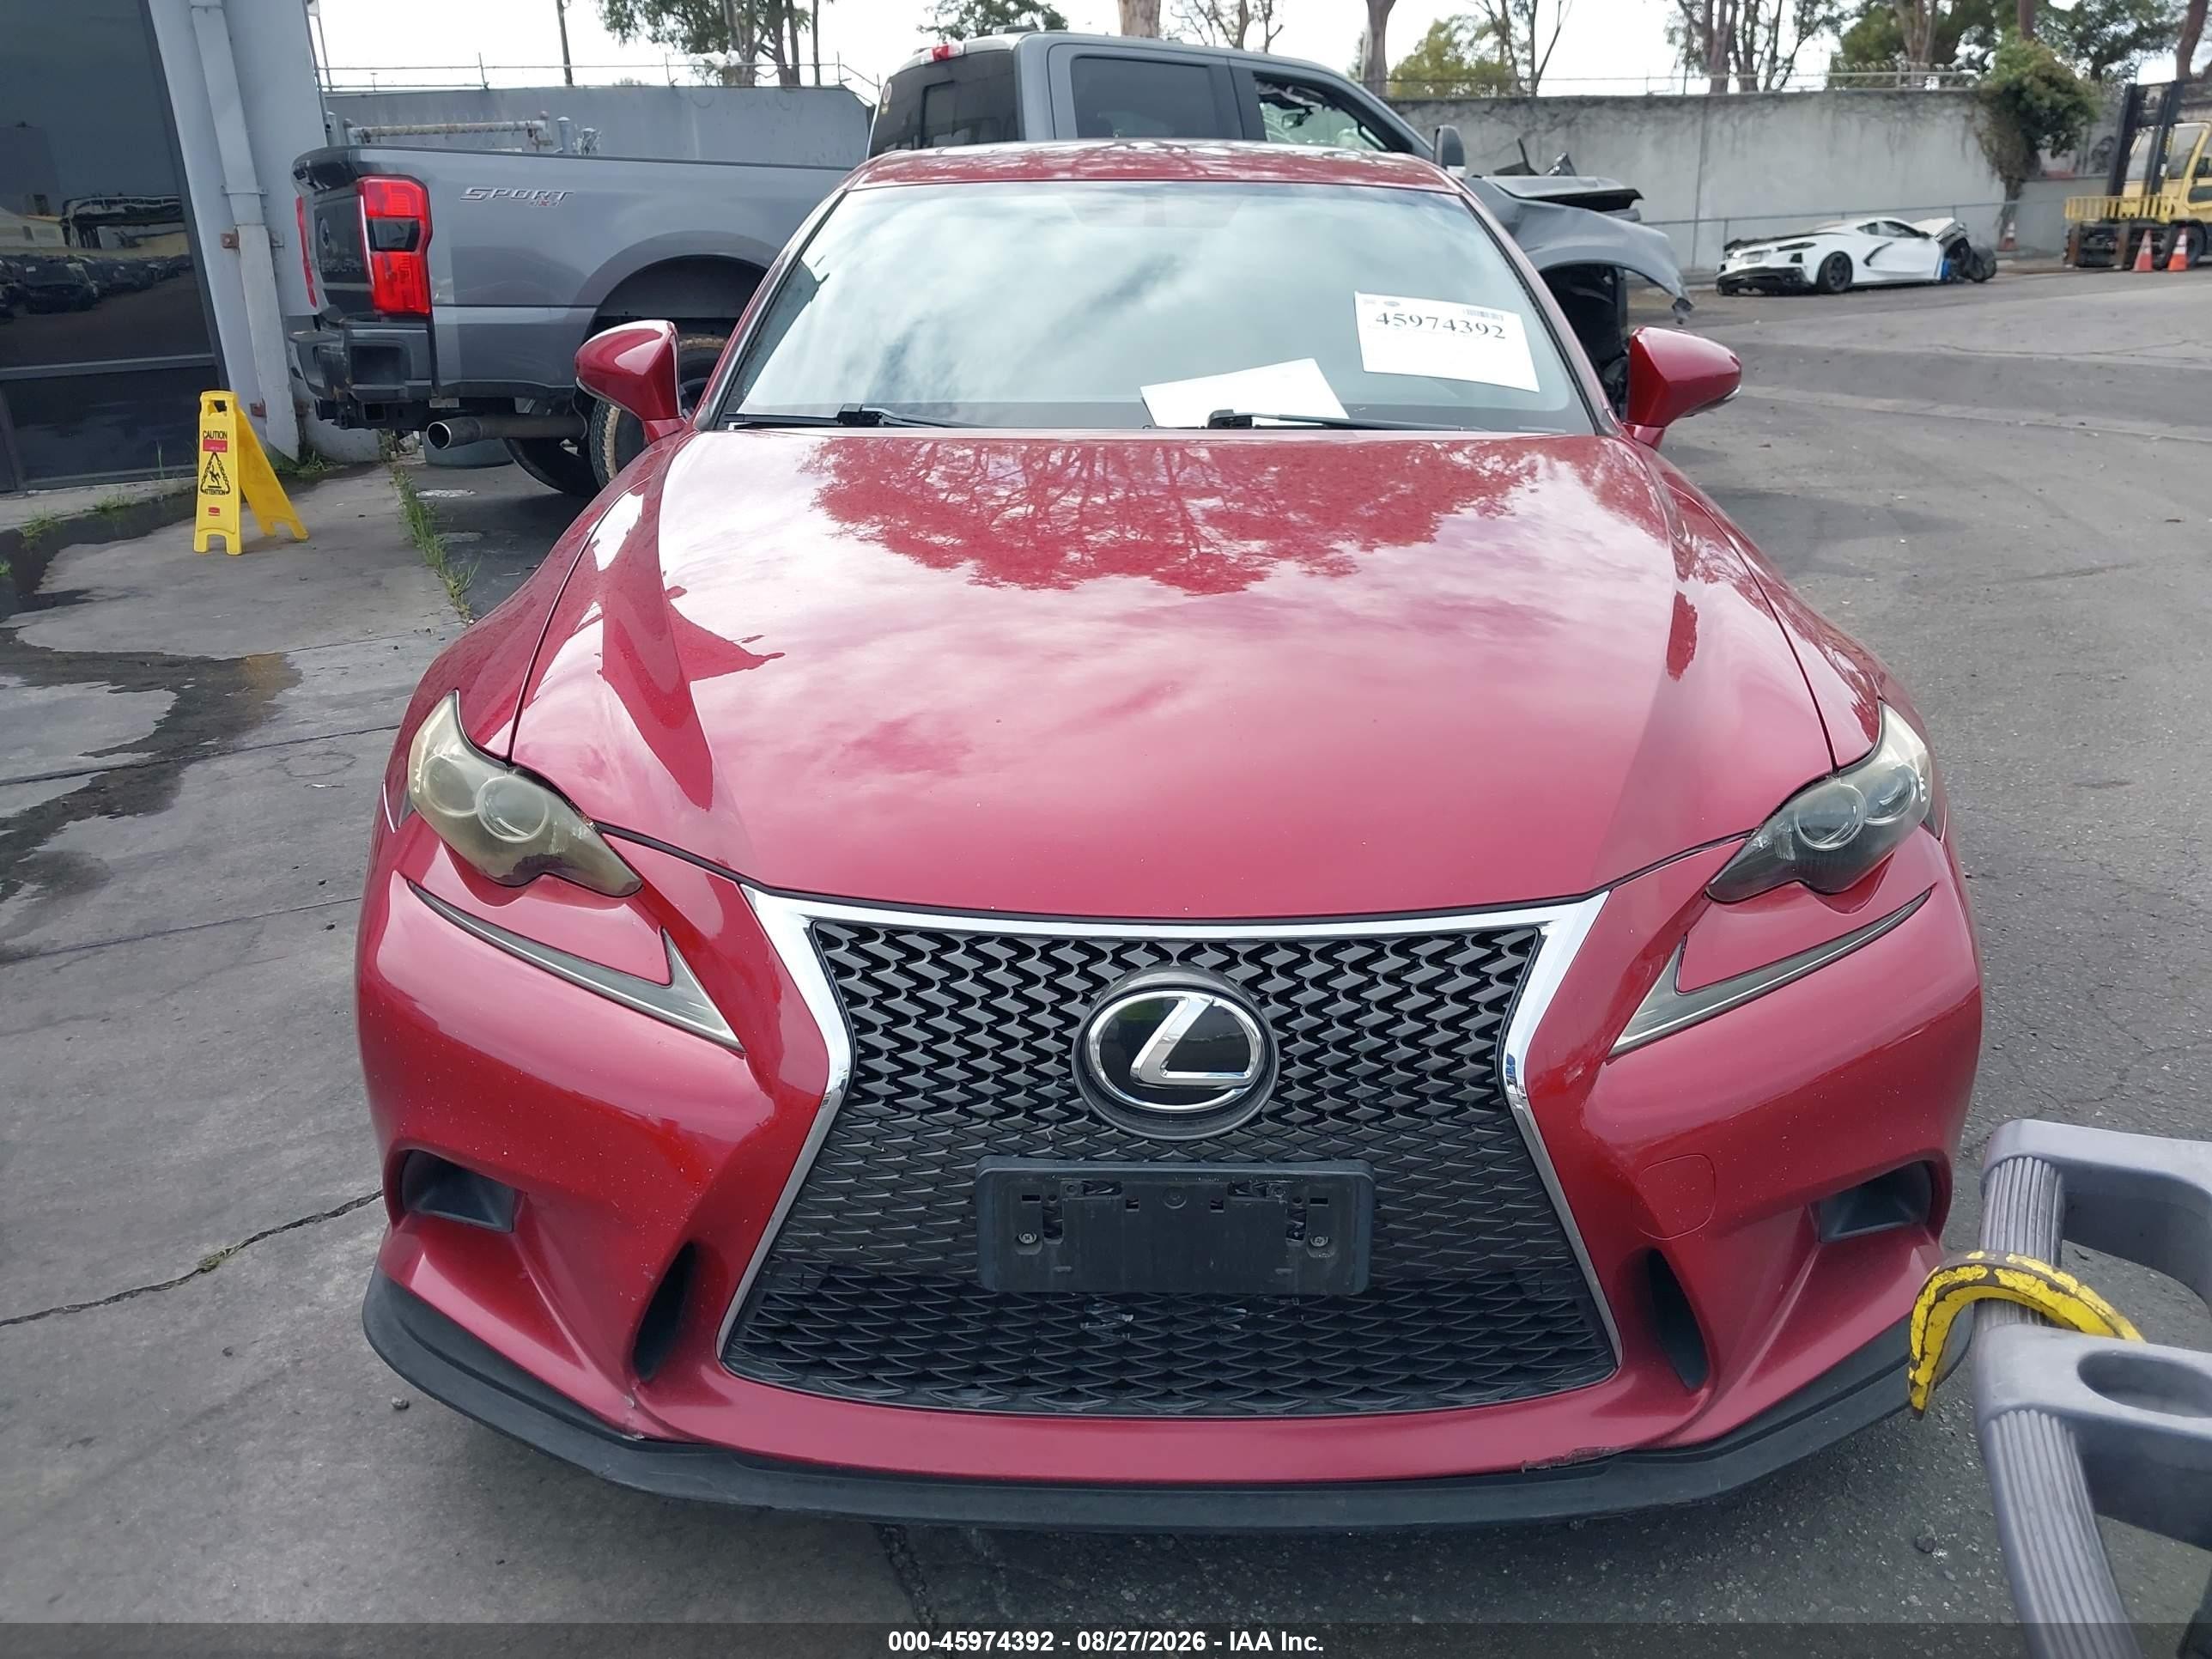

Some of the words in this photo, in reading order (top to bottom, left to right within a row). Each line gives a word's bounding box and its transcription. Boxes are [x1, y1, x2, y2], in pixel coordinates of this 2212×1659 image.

[460, 186, 574, 201] SPORT
[1375, 312, 1506, 339] 45974392
[203, 430, 228, 440] CAUTION
